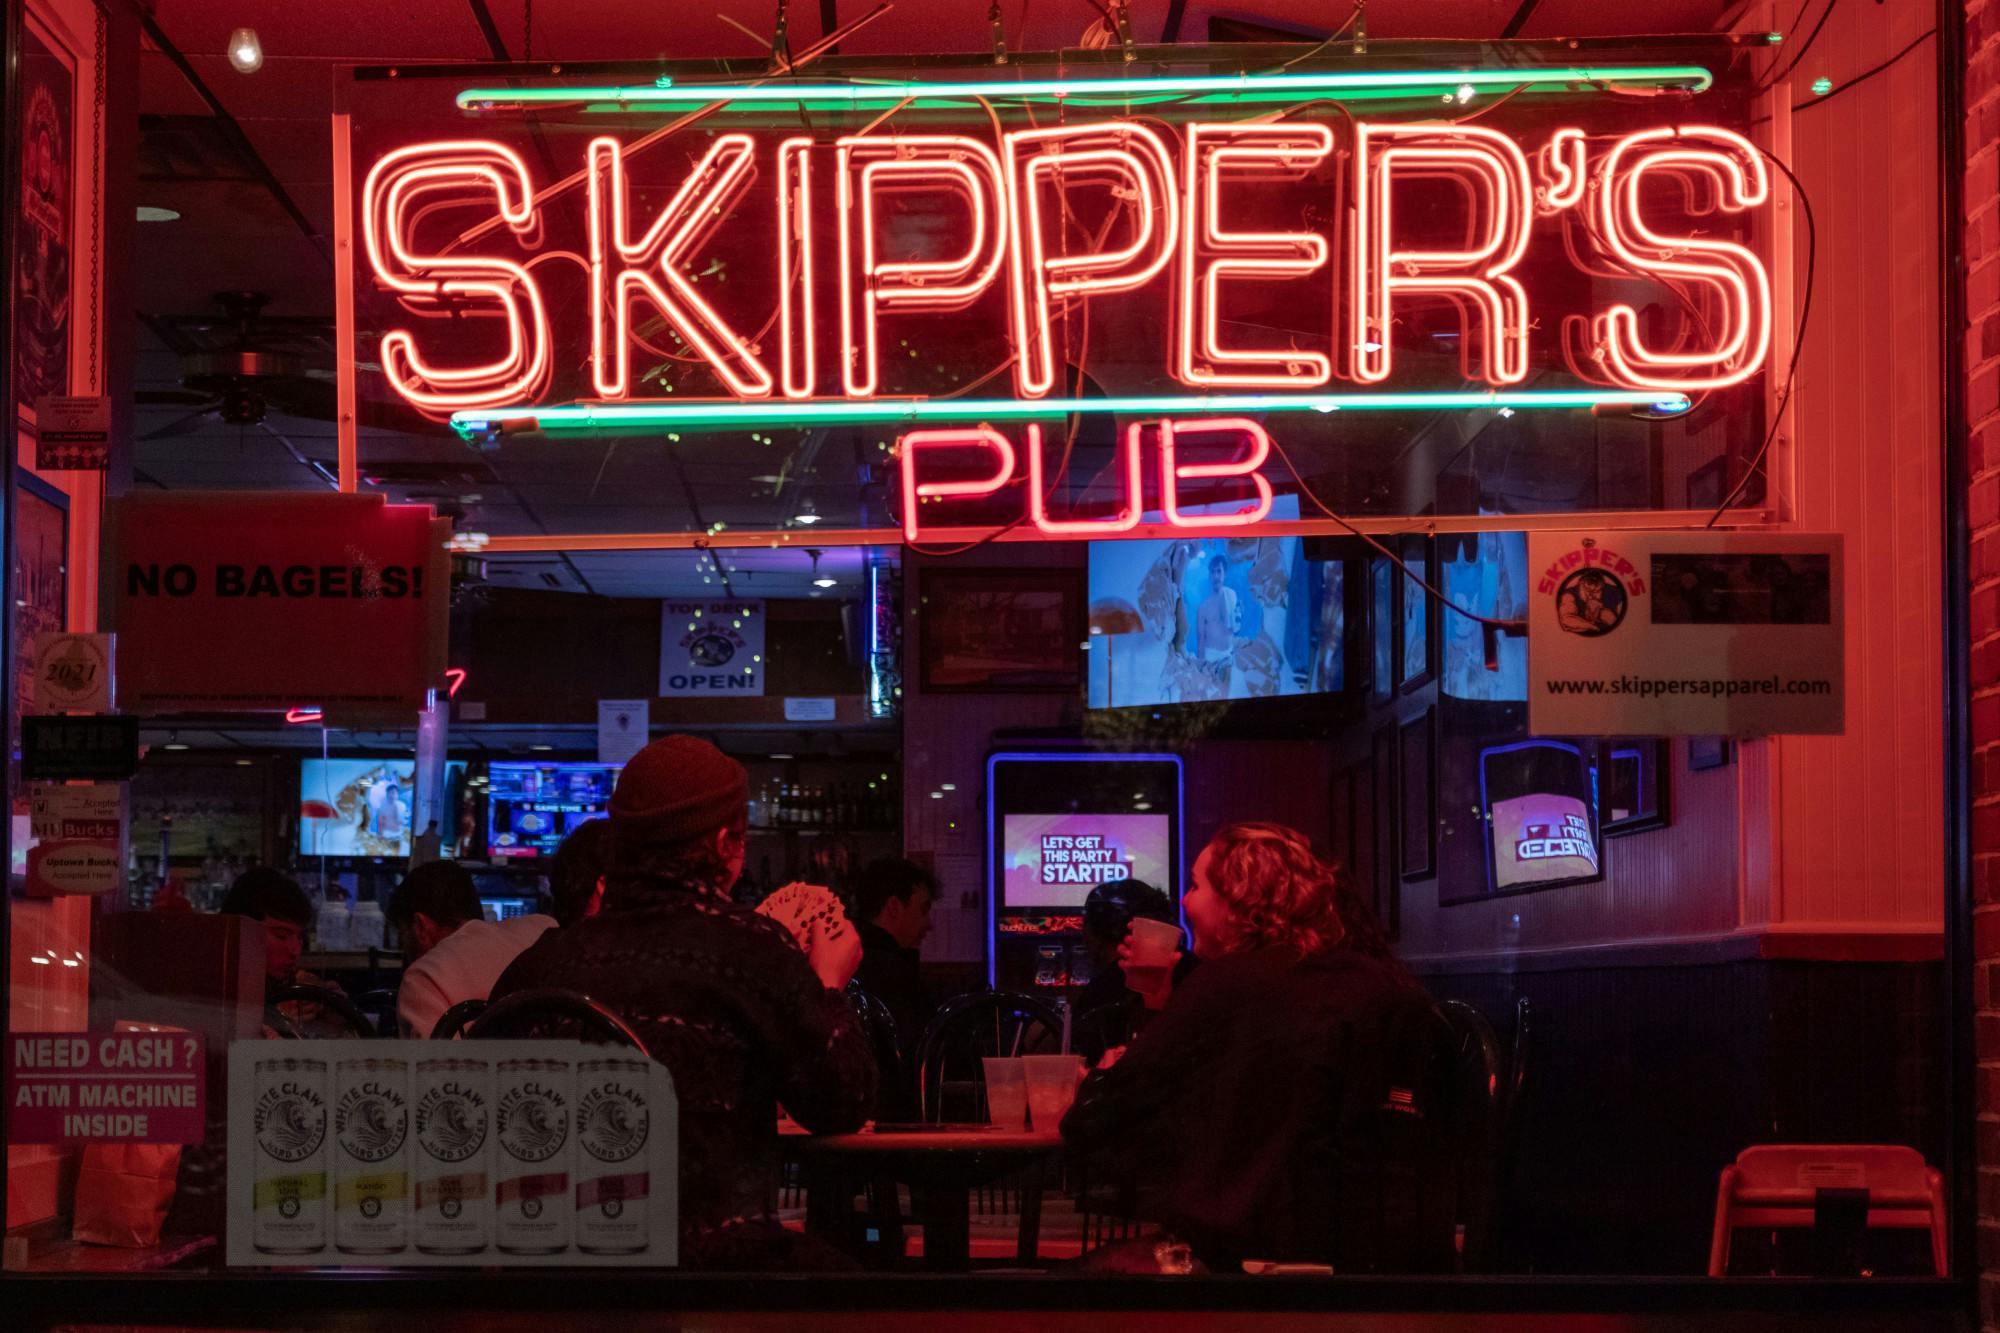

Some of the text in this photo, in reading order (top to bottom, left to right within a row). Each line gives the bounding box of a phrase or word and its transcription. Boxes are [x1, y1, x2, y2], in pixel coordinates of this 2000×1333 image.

[362, 121, 1772, 412] SKIPPER'S
[899, 417, 1274, 543] PUB
[127, 564, 423, 598] NO BAGELS!
[1538, 547, 1646, 597] SKIPPER'S
[46, 664, 97, 681] 2021
[669, 675, 755, 689] OPEN!
[1546, 675, 1831, 697] www.skippersapparel.com
[1043, 836, 1101, 849] LET'S GET
[1043, 851, 1113, 862] THIS PARTY
[1043, 864, 1129, 883] STARTED
[16, 1039, 198, 1069] NEED CASH ?
[16, 1085, 197, 1107] ATM MACHINE
[255, 1083, 324, 1134] WHITE CLAW
[336, 1083, 405, 1134] WHITE CLAW
[416, 1083, 485, 1134] WHITE CLAW
[497, 1083, 566, 1134] WHITE CLAW
[577, 1083, 646, 1134] WHITE CLAW
[65, 1115, 148, 1137] INSIDE
[356, 1183, 388, 1191] MANGO
